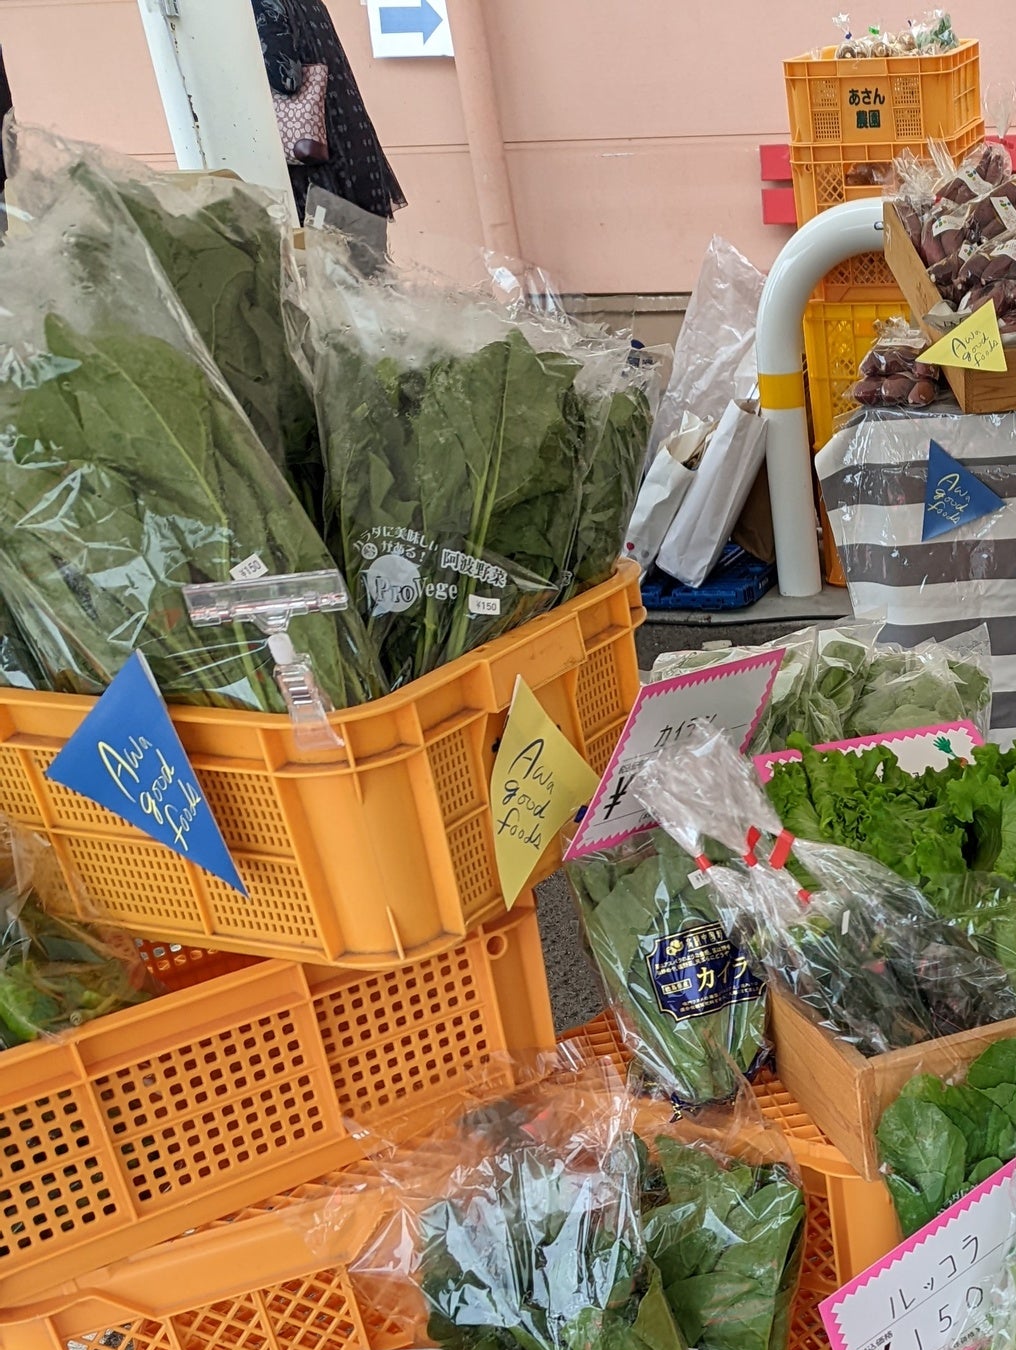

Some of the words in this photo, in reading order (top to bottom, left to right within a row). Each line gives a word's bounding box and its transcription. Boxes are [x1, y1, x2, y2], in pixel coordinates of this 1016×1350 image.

[849, 88, 885, 106] あさん
[440, 549, 507, 588] 阿波野菜
[476, 601, 497, 611] ¥150
[98, 736, 153, 804] Awa
[140, 748, 175, 825] good
[508, 738, 555, 795] Awa
[164, 779, 202, 852] foods
[502, 779, 552, 819] good
[497, 807, 541, 850] foods
[889, 1235, 978, 1319] ルッコラ
